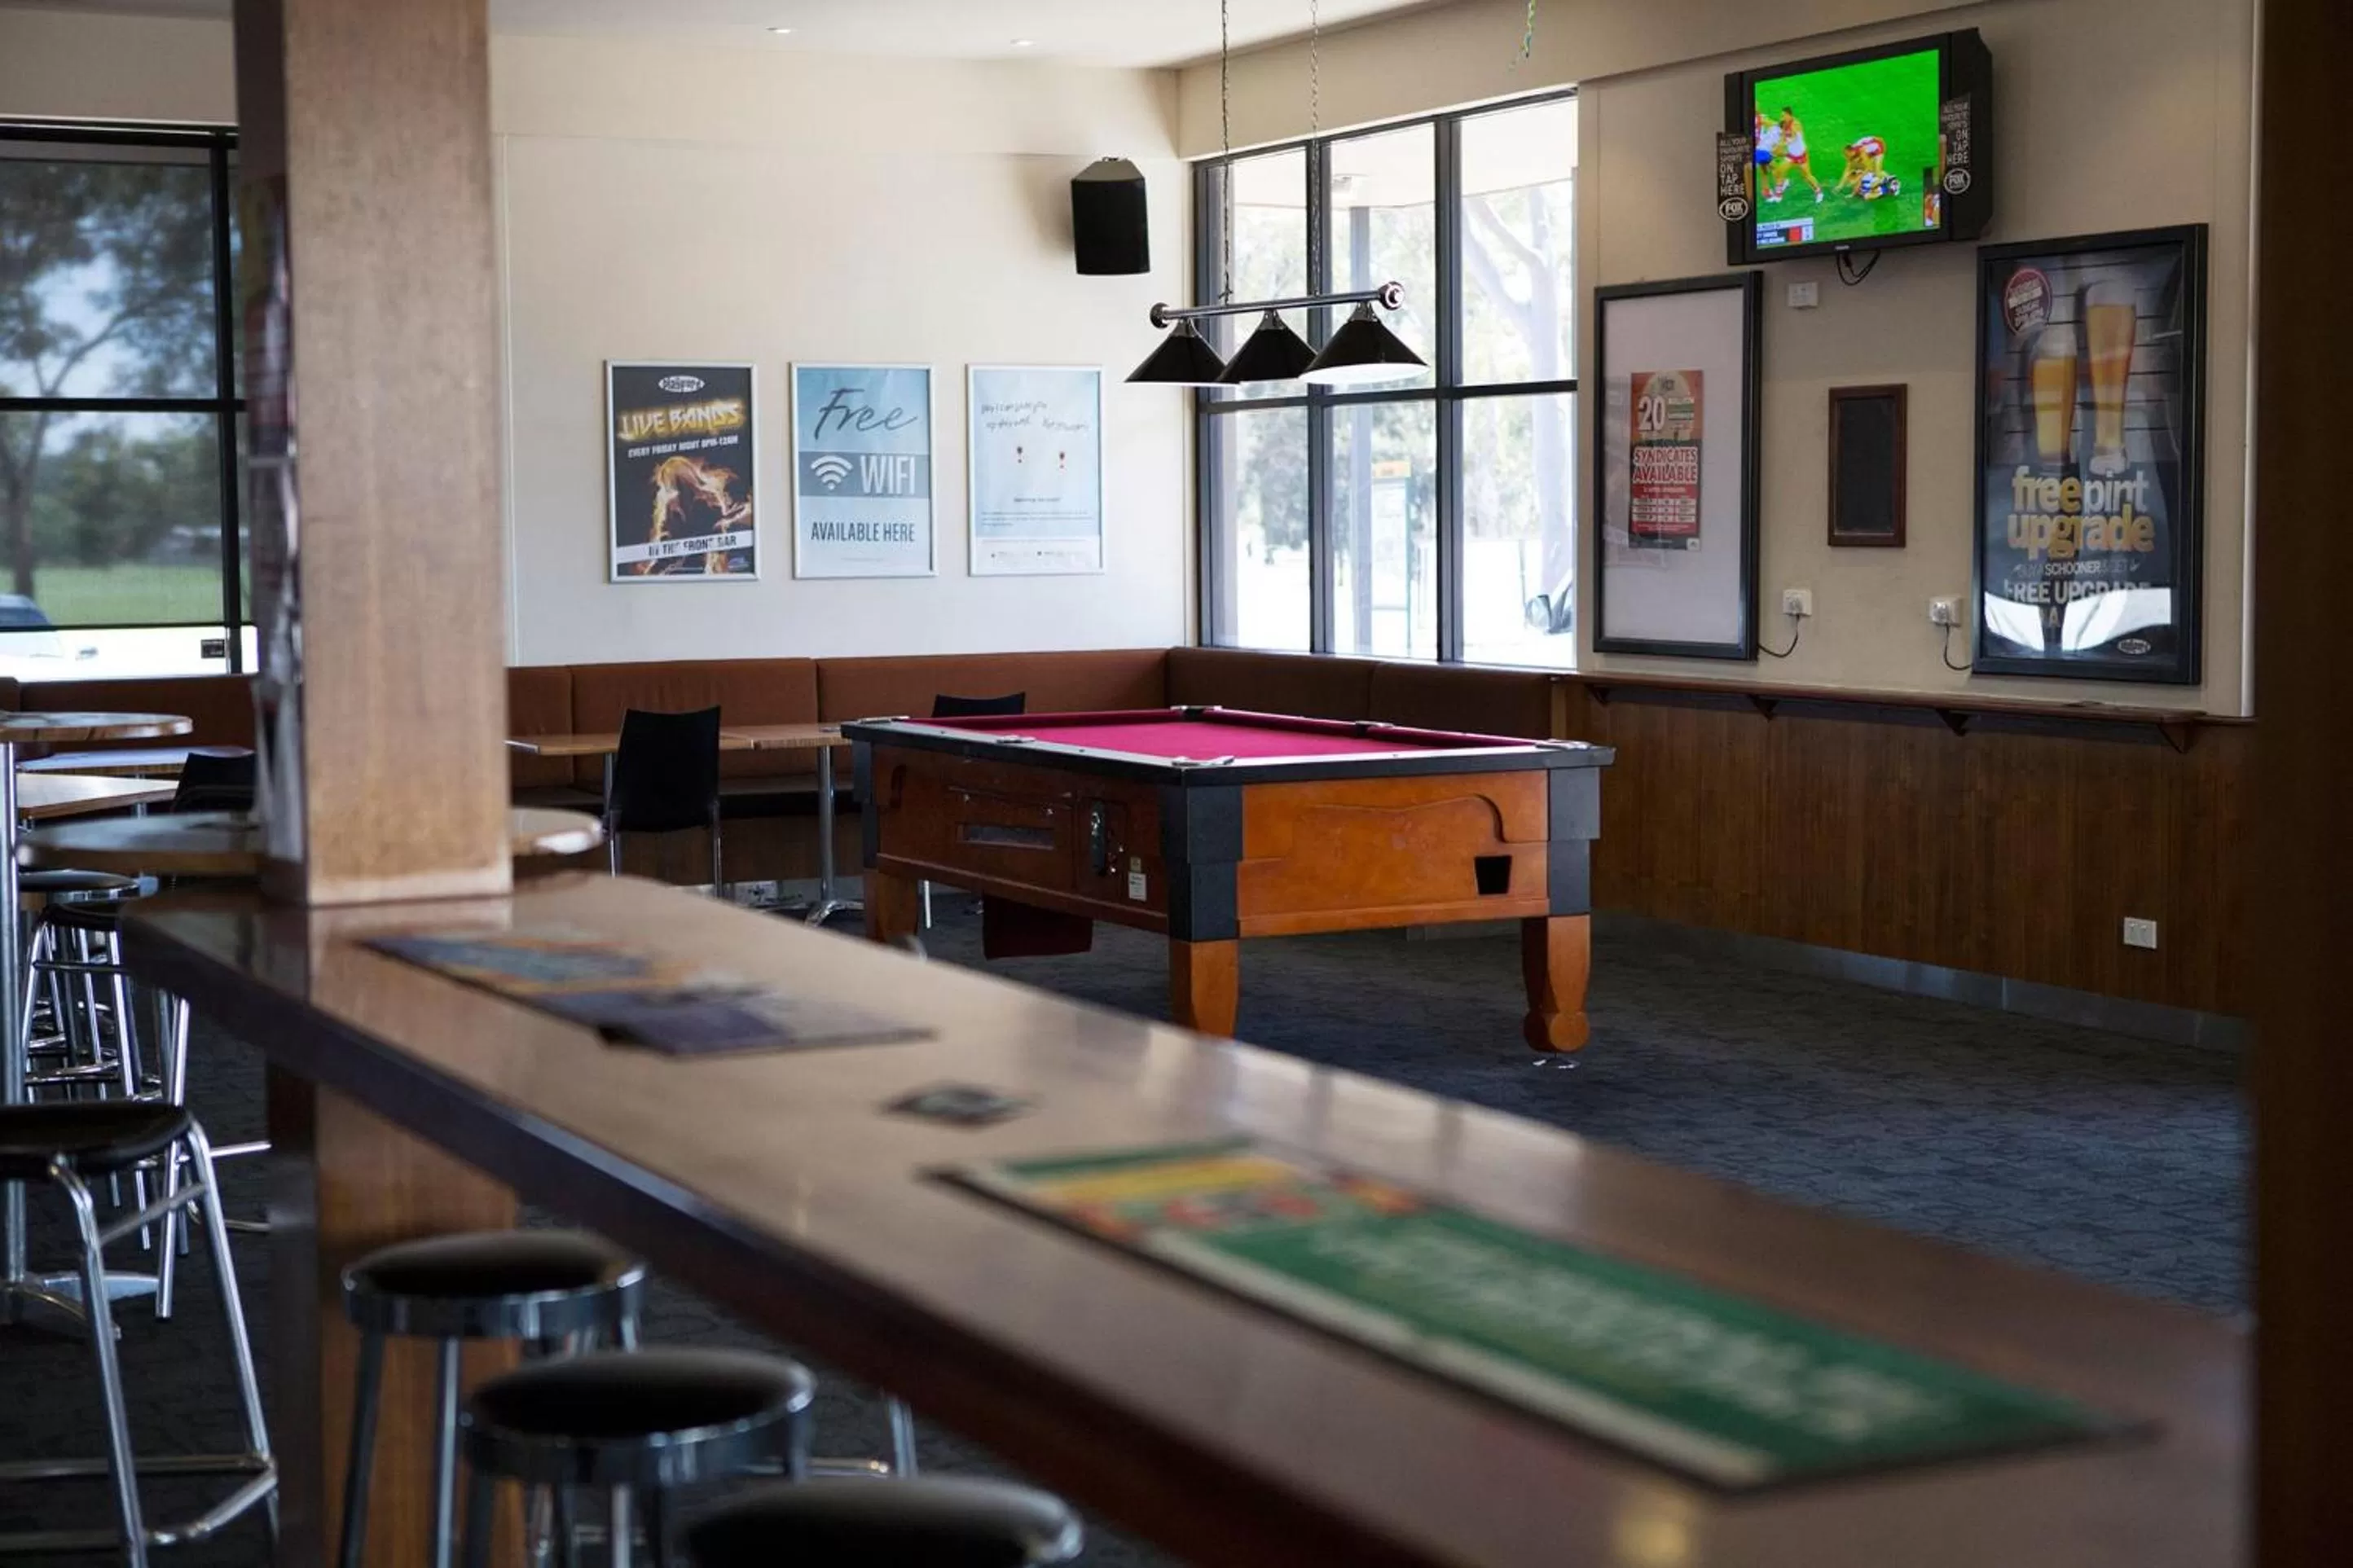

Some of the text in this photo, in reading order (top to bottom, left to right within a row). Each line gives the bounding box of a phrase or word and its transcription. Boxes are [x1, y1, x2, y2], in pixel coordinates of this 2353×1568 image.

[1956, 130, 1968, 140] ON
[1953, 139, 1968, 151] TAP
[1946, 152, 1968, 165] HERE
[1720, 162, 1734, 173] ON
[1720, 173, 1739, 185] TAP
[1949, 173, 1965, 184] FOX
[1720, 183, 1745, 195] HERE
[1725, 201, 1744, 213] FOX
[813, 388, 918, 441] Free
[1638, 395, 1665, 431] 20
[618, 411, 666, 441] LIVE
[652, 443, 677, 455] FRIDAY
[679, 440, 700, 451] NIGHT
[1634, 448, 1697, 463] SYNDICATES
[860, 455, 916, 494] WIFI
[1633, 464, 1697, 481] AVAILABLE
[2012, 465, 2149, 514] free pint
[811, 521, 915, 542] AVAILABLE HERE
[2008, 503, 2155, 560] upgrade
[684, 537, 713, 552] FRONT
[717, 534, 737, 547] BAR
[2044, 560, 2100, 578] SCHOONER
[2003, 579, 2152, 604] FREE UPGR
